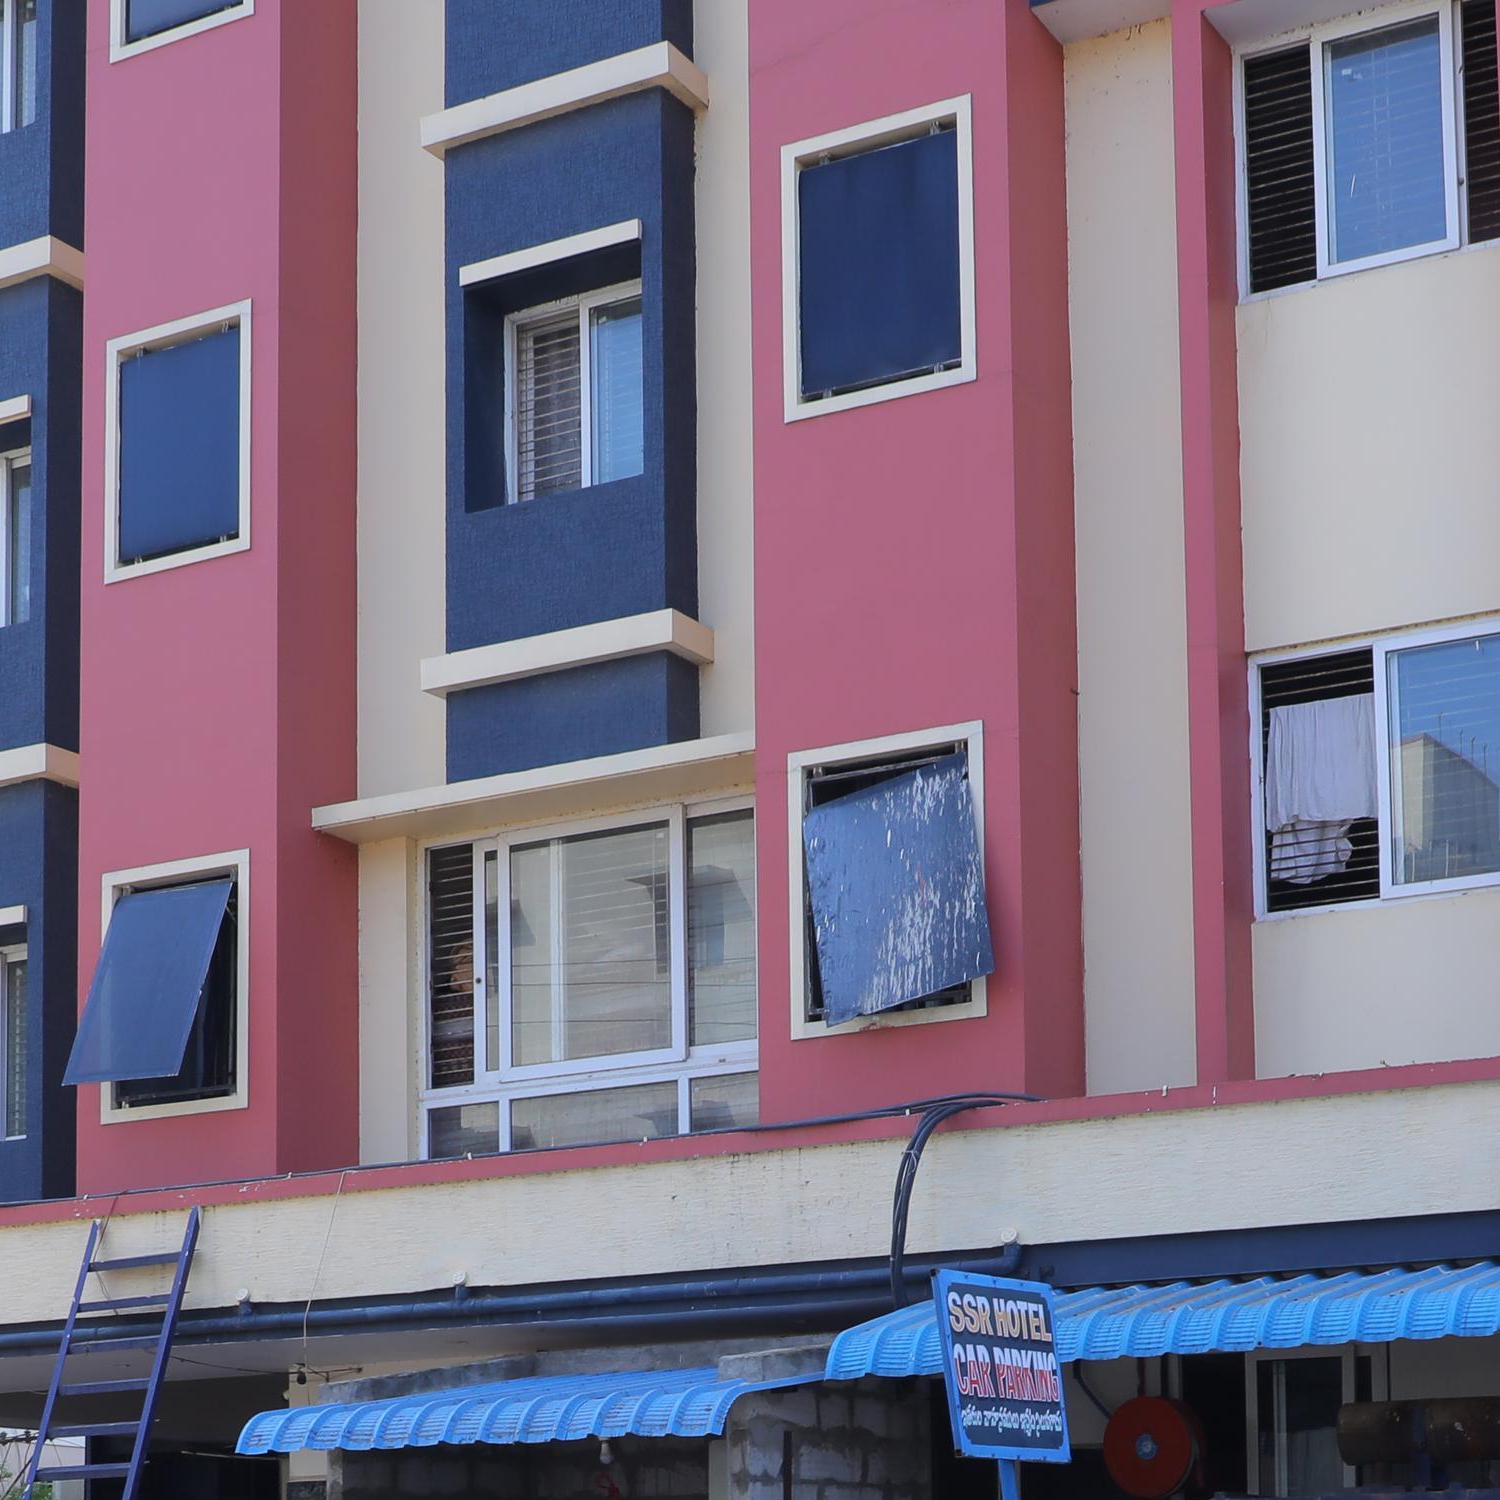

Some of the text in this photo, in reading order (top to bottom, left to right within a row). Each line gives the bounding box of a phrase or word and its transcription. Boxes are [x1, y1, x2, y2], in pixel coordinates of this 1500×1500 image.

[947, 1291, 1053, 1342] SSR HOTEL
[953, 1343, 1061, 1402] CAR PARKING
